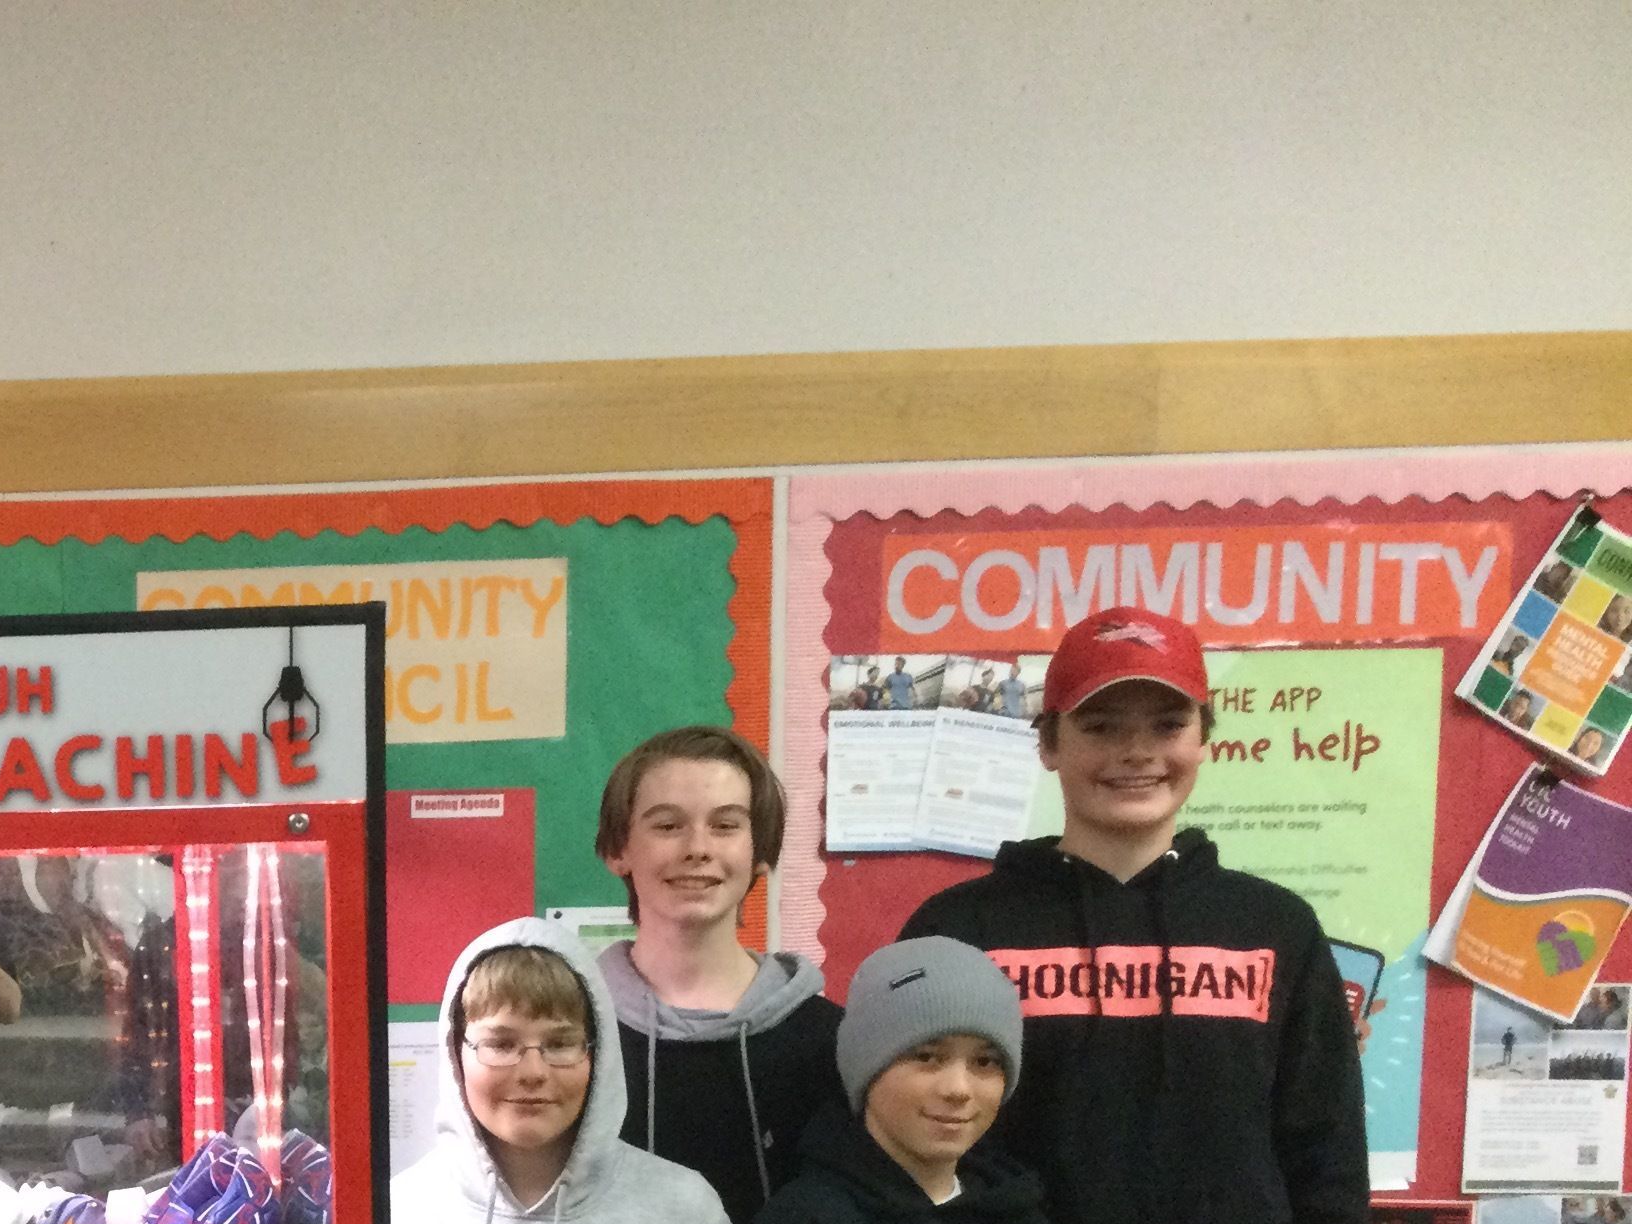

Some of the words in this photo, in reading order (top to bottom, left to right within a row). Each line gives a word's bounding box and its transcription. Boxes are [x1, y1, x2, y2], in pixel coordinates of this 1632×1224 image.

[887, 540, 1499, 635] COMMUNITY
[143, 576, 565, 641] UNITY
[1207, 687, 1257, 713] THE
[1269, 686, 1322, 712] APP
[1210, 738, 1271, 763] me
[1293, 719, 1381, 773] help
[415, 799, 458, 811] Meeting
[461, 798, 500, 810] Agenda
[1186, 805, 1225, 814] health
[1228, 803, 1294, 814] counselors
[1297, 804, 1318, 812] are
[1323, 801, 1367, 815] waiting
[1520, 794, 1572, 830] YOUTH
[1218, 820, 1240, 830] call
[1243, 821, 1255, 830] or
[1260, 820, 1284, 830] text
